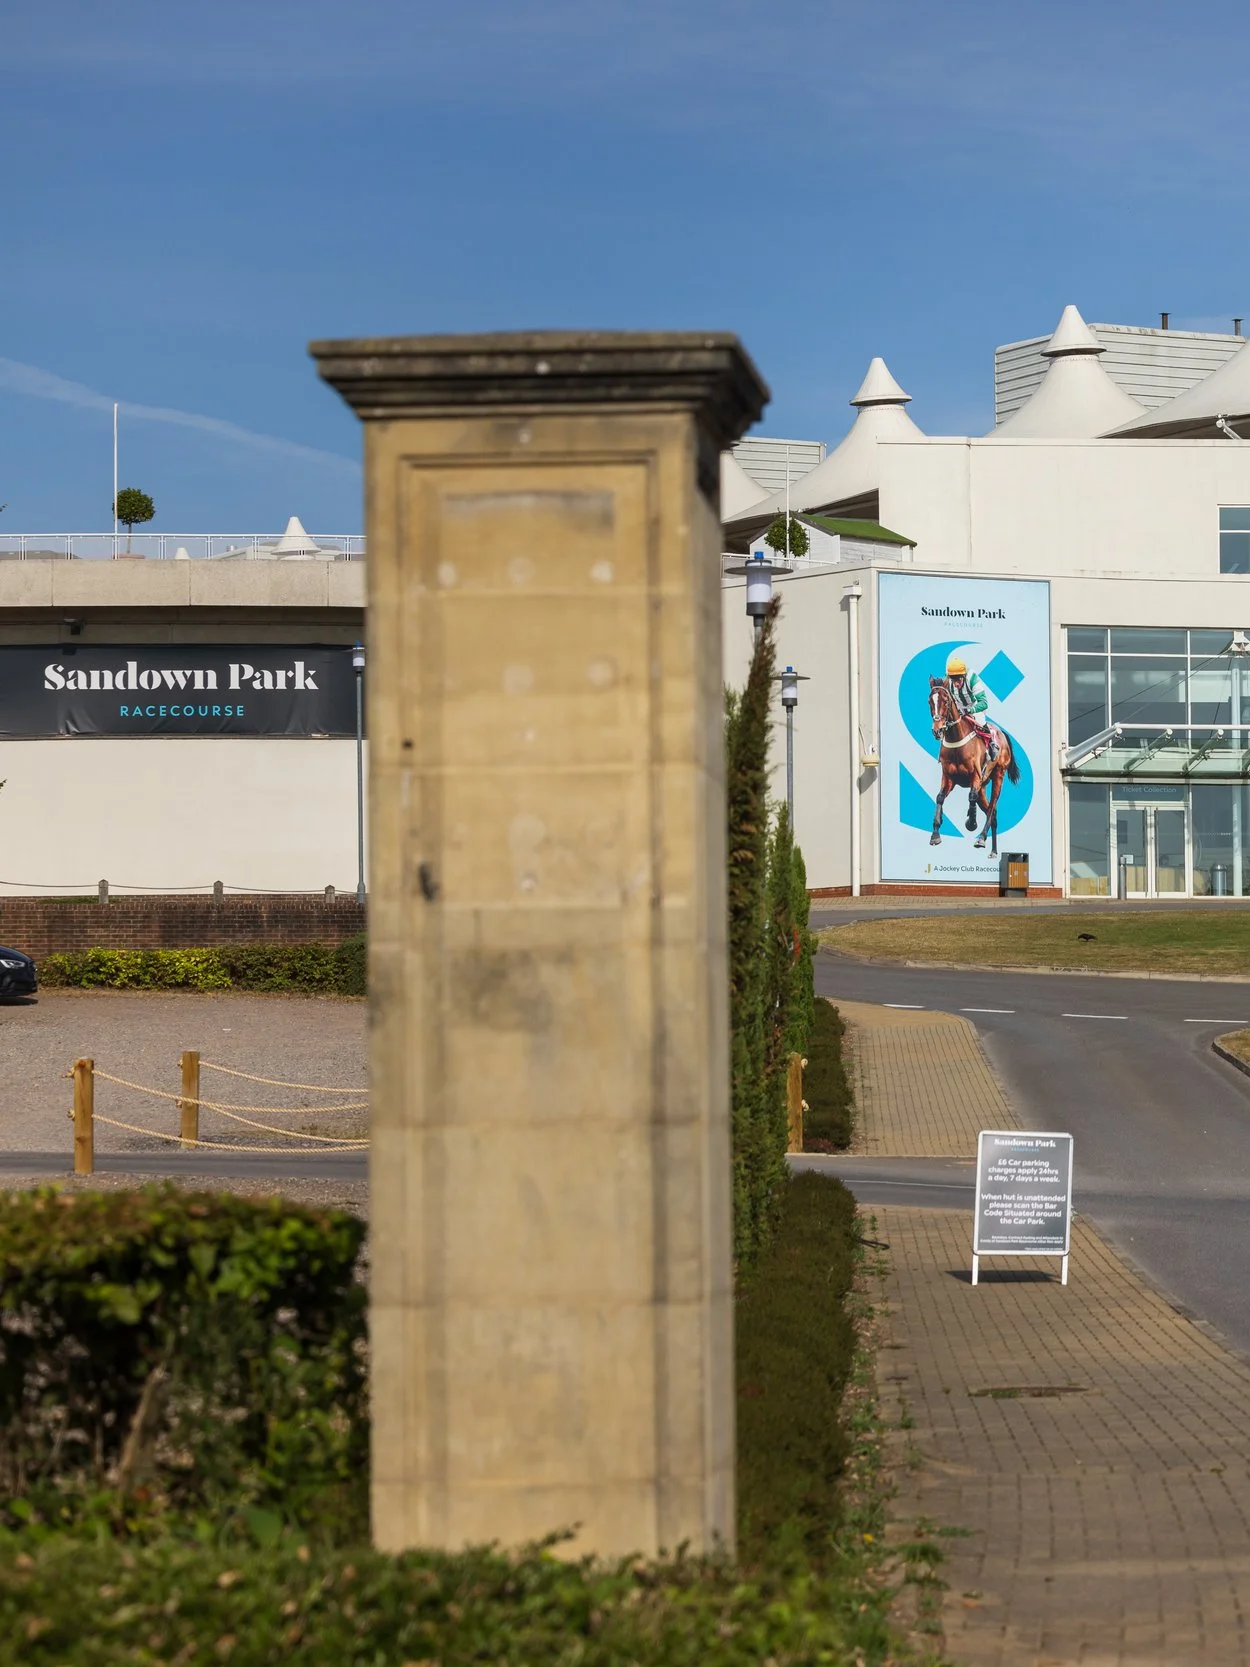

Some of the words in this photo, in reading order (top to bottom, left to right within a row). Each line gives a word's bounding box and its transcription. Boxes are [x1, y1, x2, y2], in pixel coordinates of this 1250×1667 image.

[921, 606, 975, 619] Sandown
[978, 608, 1006, 620] Park
[44, 661, 217, 690] Sandown
[228, 661, 320, 690] Park
[120, 705, 246, 717] RACECOURSE
[939, 865, 960, 873] Jockey
[1035, 1139, 1056, 1148] Park
[1022, 1159, 1049, 1168] parking
[988, 1166, 1016, 1175] charges
[1017, 1167, 1037, 1175] apply
[1038, 1167, 1058, 1175] 24hrs
[994, 1174, 1008, 1182] day,
[1016, 1175, 1032, 1183] days
[1024, 1194, 1066, 1202] unattended
[984, 1209, 1002, 1217] Code
